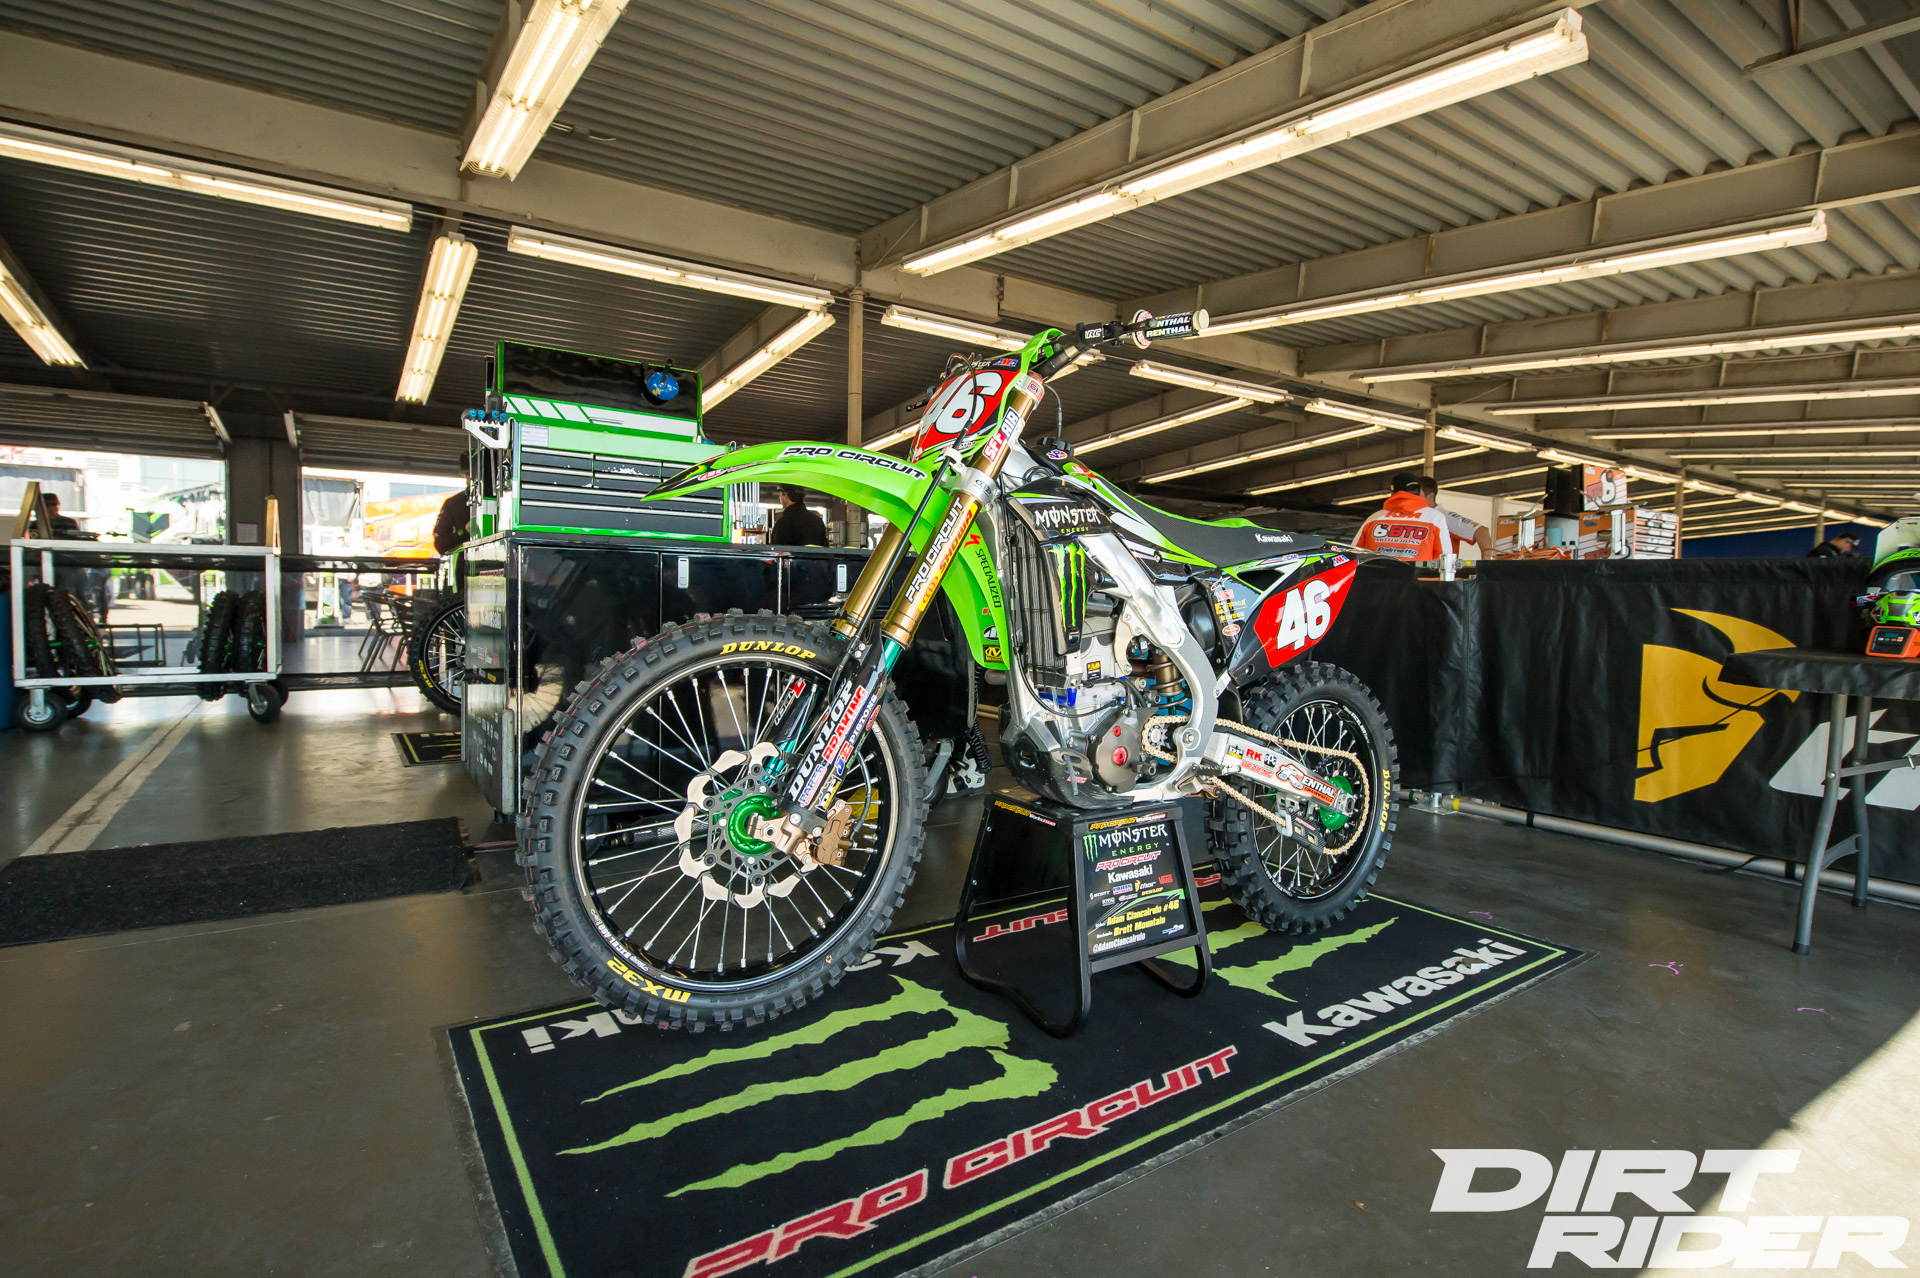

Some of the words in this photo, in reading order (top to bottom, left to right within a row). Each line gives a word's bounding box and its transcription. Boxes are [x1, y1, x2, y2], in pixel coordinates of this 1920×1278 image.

[1146, 325, 1192, 338] RENTHAL
[1156, 316, 1191, 328] NTHAL
[919, 370, 1003, 436] 46
[983, 430, 1006, 462] SFF
[1001, 407, 1019, 436] AIR
[778, 446, 834, 459] PRO
[836, 450, 926, 479] CIRCUIT
[1034, 506, 1101, 529] MONSTER
[940, 510, 973, 574] SHOWA
[1254, 533, 1293, 543] Kawasaki
[1388, 525, 1428, 540] BTO
[905, 562, 930, 603] PRO
[925, 497, 963, 566] CIRCUIT
[1377, 546, 1418, 555] Palmetto
[975, 548, 1001, 608] SPECIALIZED
[1277, 578, 1331, 651] 46
[720, 640, 816, 660] DUNLOP
[822, 686, 868, 764] BRAKING
[834, 741, 854, 776] JE
[849, 694, 877, 745] PISTONS
[788, 680, 853, 802] DUNLOP
[1246, 748, 1262, 761] RK
[1241, 761, 1274, 778] BRAKING
[800, 764, 824, 803] PARTS
[1380, 769, 1391, 832] DUNLOP
[1098, 823, 1168, 848] MONSTER
[1095, 859, 1120, 872] PRO
[1119, 850, 1161, 866] CIRCUIT
[1112, 842, 1159, 857] ENERGY
[1108, 864, 1153, 884] Kawasaki
[1141, 887, 1163, 896] DUNLOP
[1106, 914, 1125, 926] Adam
[1163, 900, 1180, 912] #46
[1113, 923, 1133, 936] Brett
[1134, 916, 1166, 931] Mountain
[1262, 938, 1527, 1047] Kawasaki
[682, 1168, 929, 1278] PRO
[942, 1045, 1238, 1190] CIRCUIT
